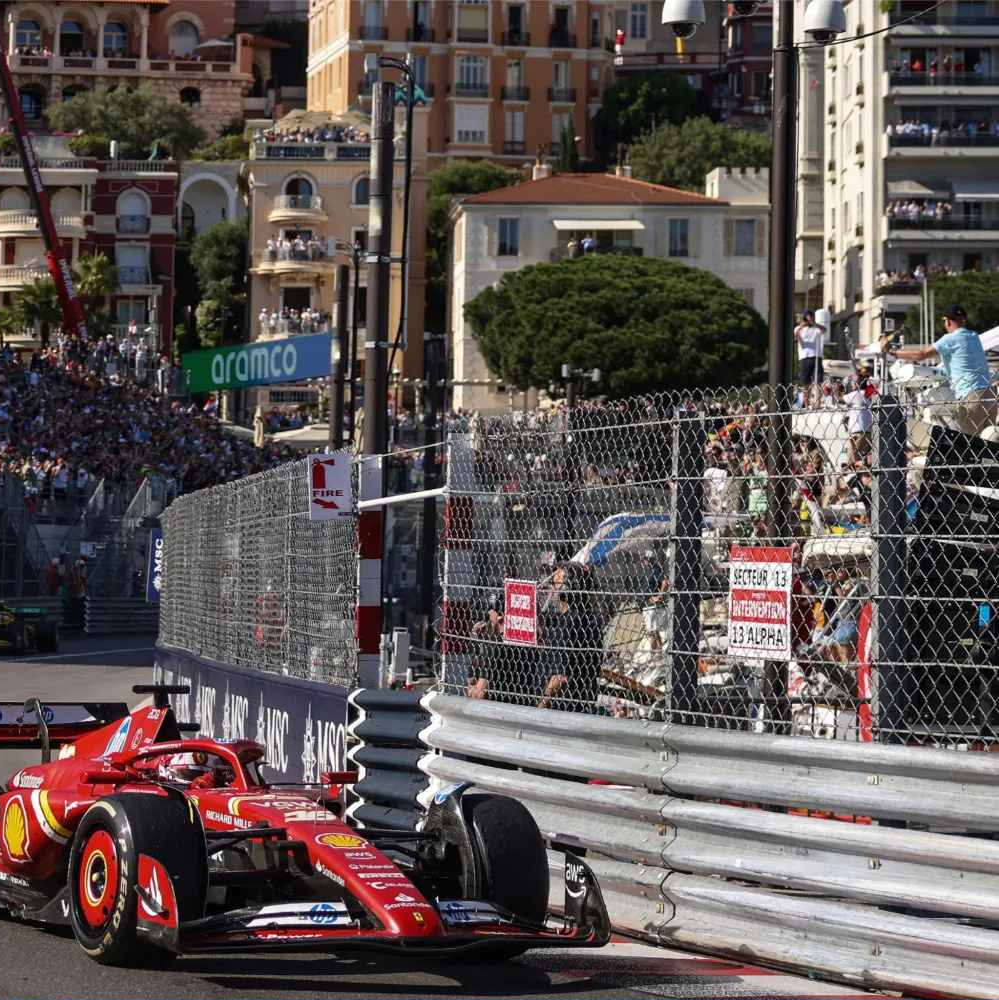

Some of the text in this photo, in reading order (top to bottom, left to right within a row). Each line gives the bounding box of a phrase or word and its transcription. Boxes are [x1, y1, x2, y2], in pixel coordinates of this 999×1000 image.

[59, 259, 75, 300] IMPERIAL
[211, 343, 297, 384] aramco
[312, 489, 343, 497] FIRE
[154, 539, 164, 572] MSC
[733, 569, 787, 587] SECTEUR 13
[732, 600, 785, 619] INTERVENTION
[732, 626, 784, 646] 13 ALPHA
[232, 694, 248, 740] MSC
[266, 707, 288, 774] MSC
[317, 720, 345, 783] MSC
[21, 770, 44, 788] Santander
[205, 810, 252, 829] RICHARD MILLE
[284, 811, 337, 822] 16
[321, 864, 345, 887] Santander
[566, 863, 586, 883] aws
[112, 838, 128, 930] P ZERO
